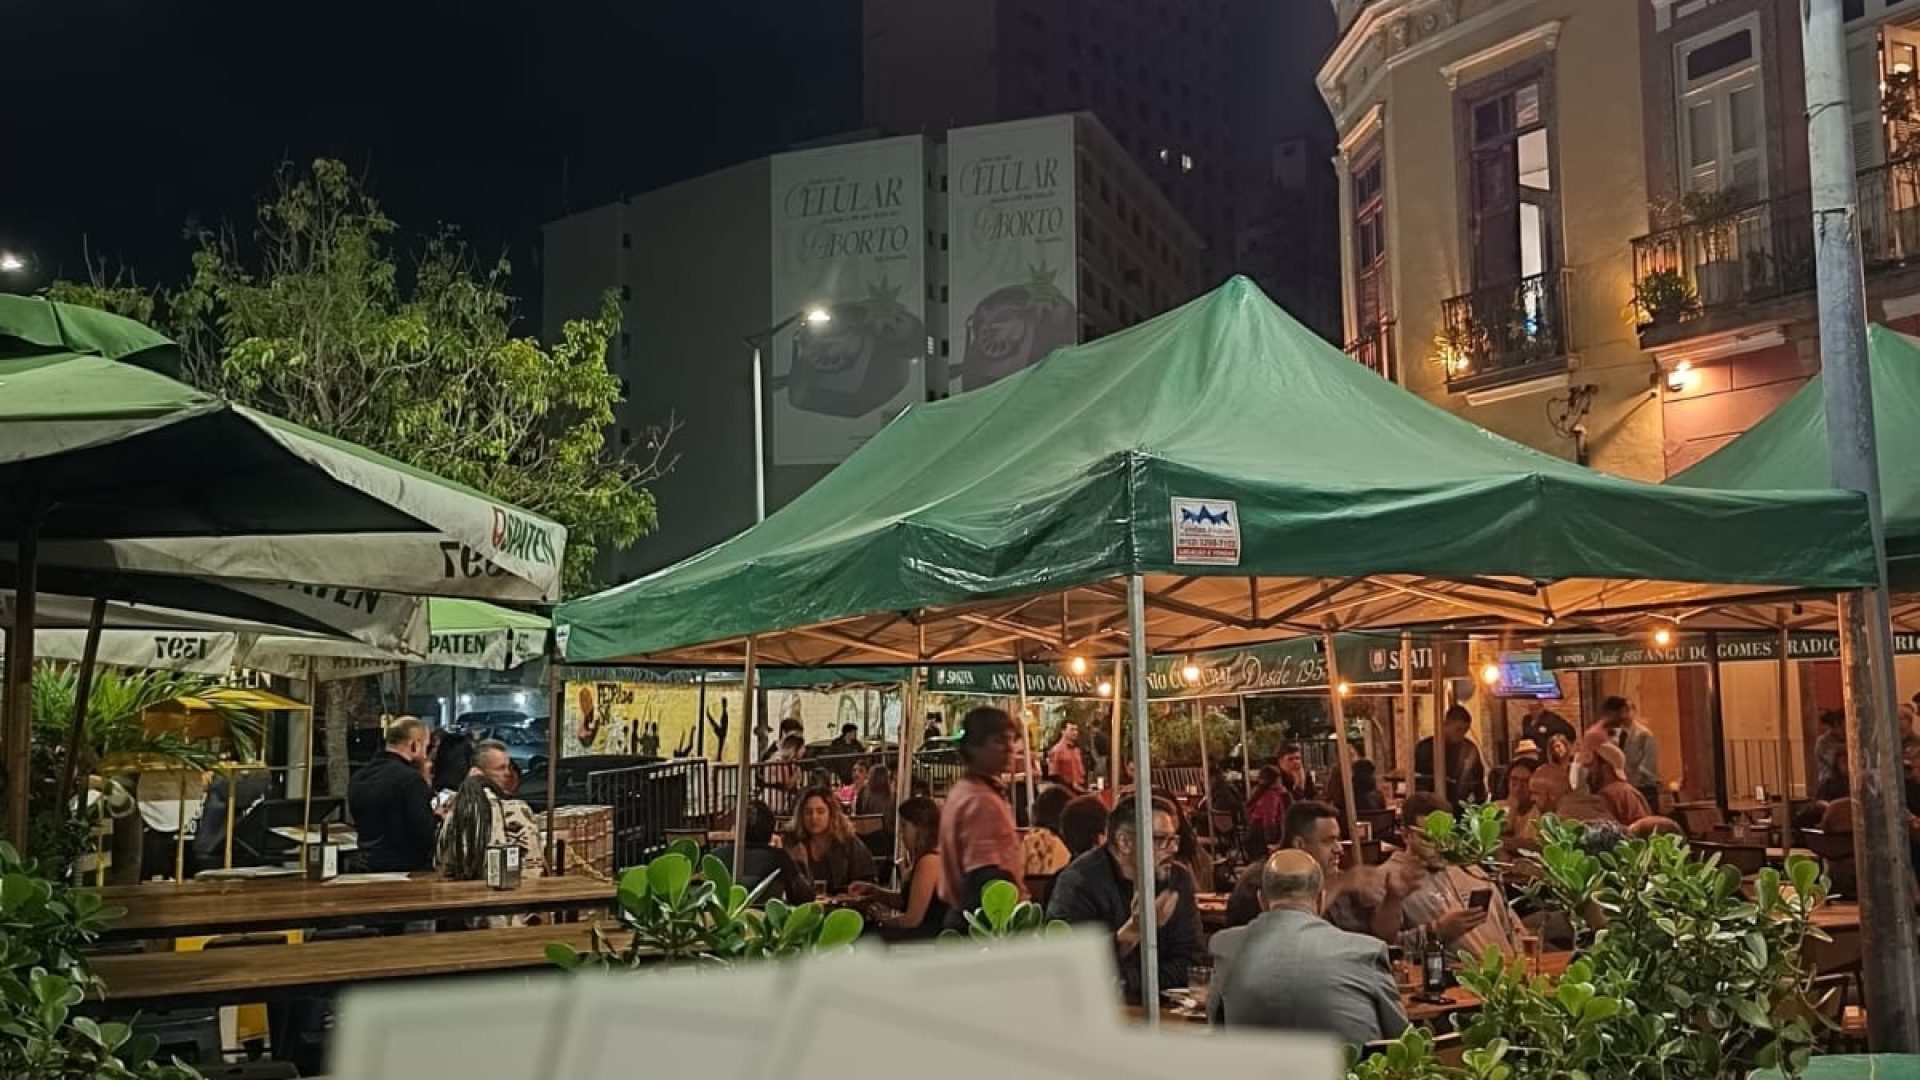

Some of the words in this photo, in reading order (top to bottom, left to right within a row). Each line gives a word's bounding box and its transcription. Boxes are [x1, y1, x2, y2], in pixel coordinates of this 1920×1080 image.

[960, 157, 1059, 197] CELULAR
[784, 177, 903, 217] CELULAR
[429, 633, 487, 654] PATEN
[1716, 641, 1772, 657] GOMES
[1776, 637, 1839, 656] RADIÇ
[1242, 656, 1292, 687] Desde
[1296, 659, 1326, 683] 195
